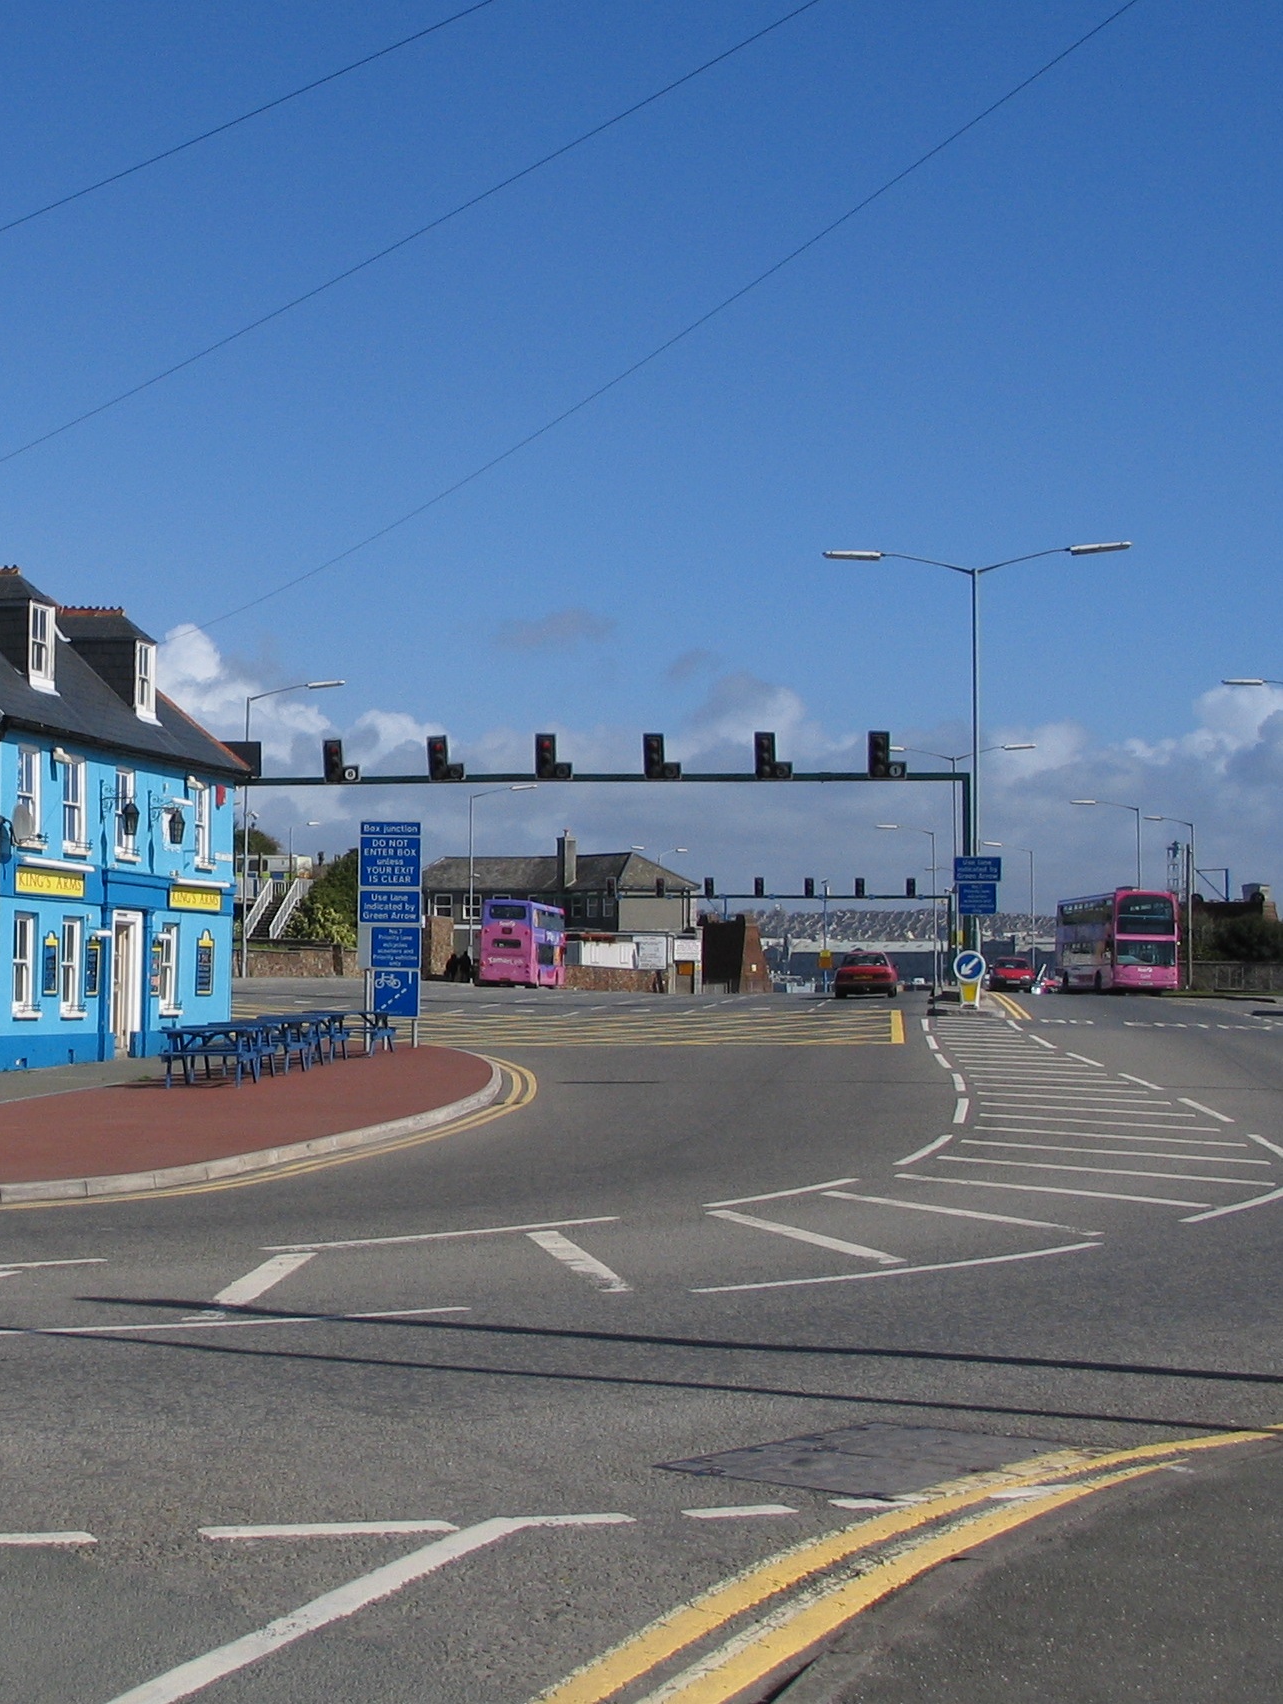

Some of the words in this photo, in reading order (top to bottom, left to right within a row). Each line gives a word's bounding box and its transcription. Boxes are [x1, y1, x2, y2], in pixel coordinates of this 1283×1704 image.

[383, 824, 418, 834] junction
[372, 839, 386, 847] DO
[388, 839, 409, 847] NOT
[364, 848, 394, 857] ENTER
[397, 849, 417, 857] BOX
[376, 858, 404, 866] unless
[366, 866, 392, 875] YOUR
[394, 866, 415, 875] EXIT
[18, 873, 52, 888] KING'S
[56, 876, 82, 892] ARMS
[369, 875, 379, 883] IS
[381, 875, 411, 883] CLEAR
[172, 891, 197, 904] KING'S
[200, 893, 219, 906] ARMS
[371, 893, 388, 901] Use
[404, 902, 416, 912] by
[362, 911, 389, 920] Green
[390, 911, 417, 920] Arrow
